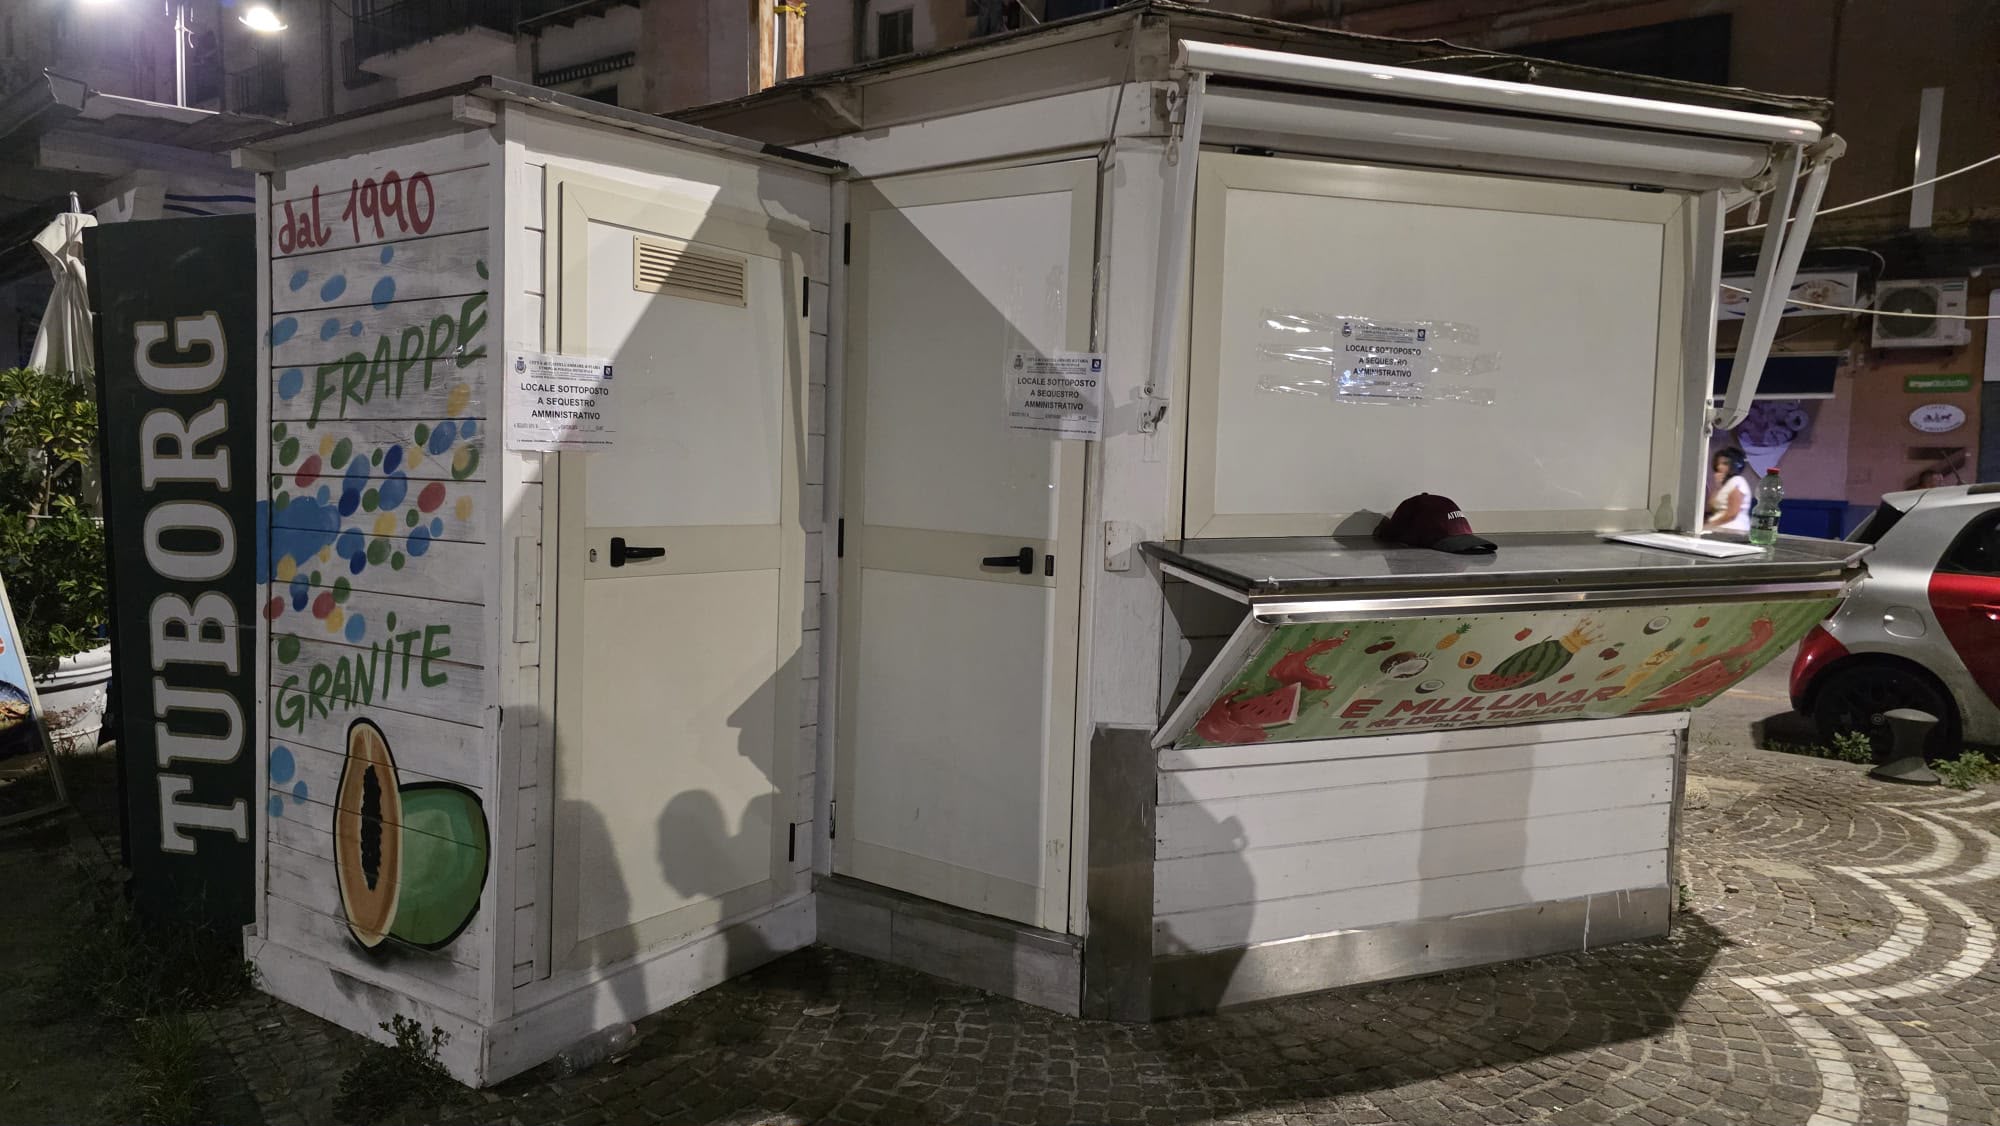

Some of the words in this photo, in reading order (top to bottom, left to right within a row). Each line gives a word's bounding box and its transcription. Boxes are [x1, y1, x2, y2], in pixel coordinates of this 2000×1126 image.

[278, 185, 332, 254] dal
[342, 170, 435, 244] 1990
[1345, 344, 1375, 353] LOCALE
[1017, 377, 1046, 386] LOCALE
[1047, 378, 1097, 388] SOTTOPOSTO
[520, 382, 556, 393] LOCALE
[557, 385, 609, 396] SOTTOPOSTO
[1030, 389, 1036, 397] A
[1037, 389, 1080, 399] SEQUESTRO
[537, 397, 544, 405] A
[546, 397, 596, 408] SEQUESTRO
[1024, 400, 1084, 411] AMMINISTRATIVO
[531, 409, 601, 421] AMMINISTRATIVO
[133, 310, 250, 856] TUBORG
[1384, 686, 1627, 718] MULUNAR
[1338, 720, 1359, 731] IL
[1404, 712, 1480, 726] DELLA
